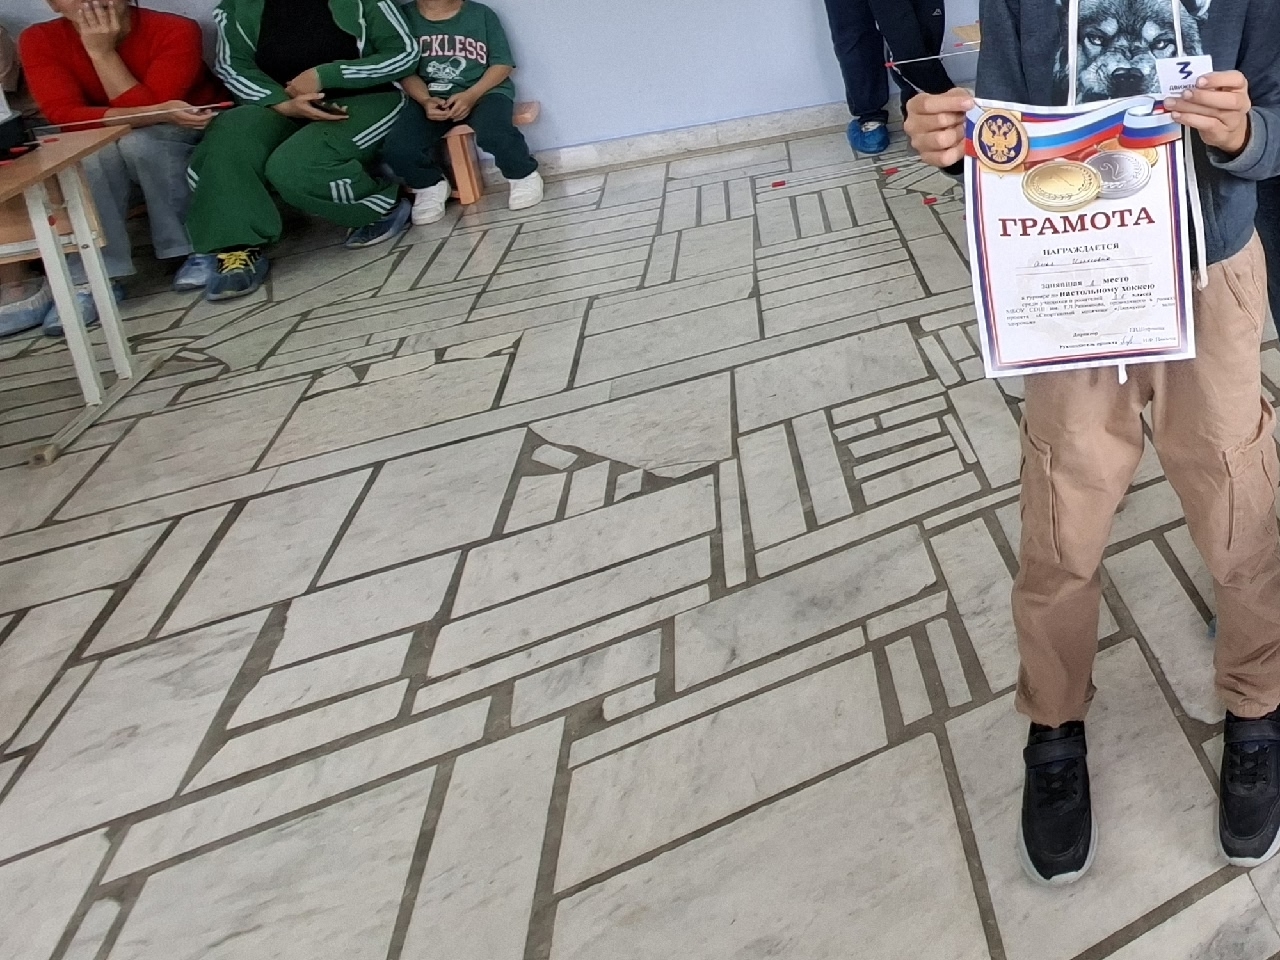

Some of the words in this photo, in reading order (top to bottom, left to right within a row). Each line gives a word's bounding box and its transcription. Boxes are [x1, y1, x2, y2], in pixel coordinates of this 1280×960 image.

[419, 34, 487, 64] CKLESS
[998, 206, 1156, 237] ГРАМОТА
[1042, 242, 1120, 257] НАГРАЖДАЕТСЯ
[1103, 276, 1129, 284] место
[1121, 283, 1156, 292] хоккею
